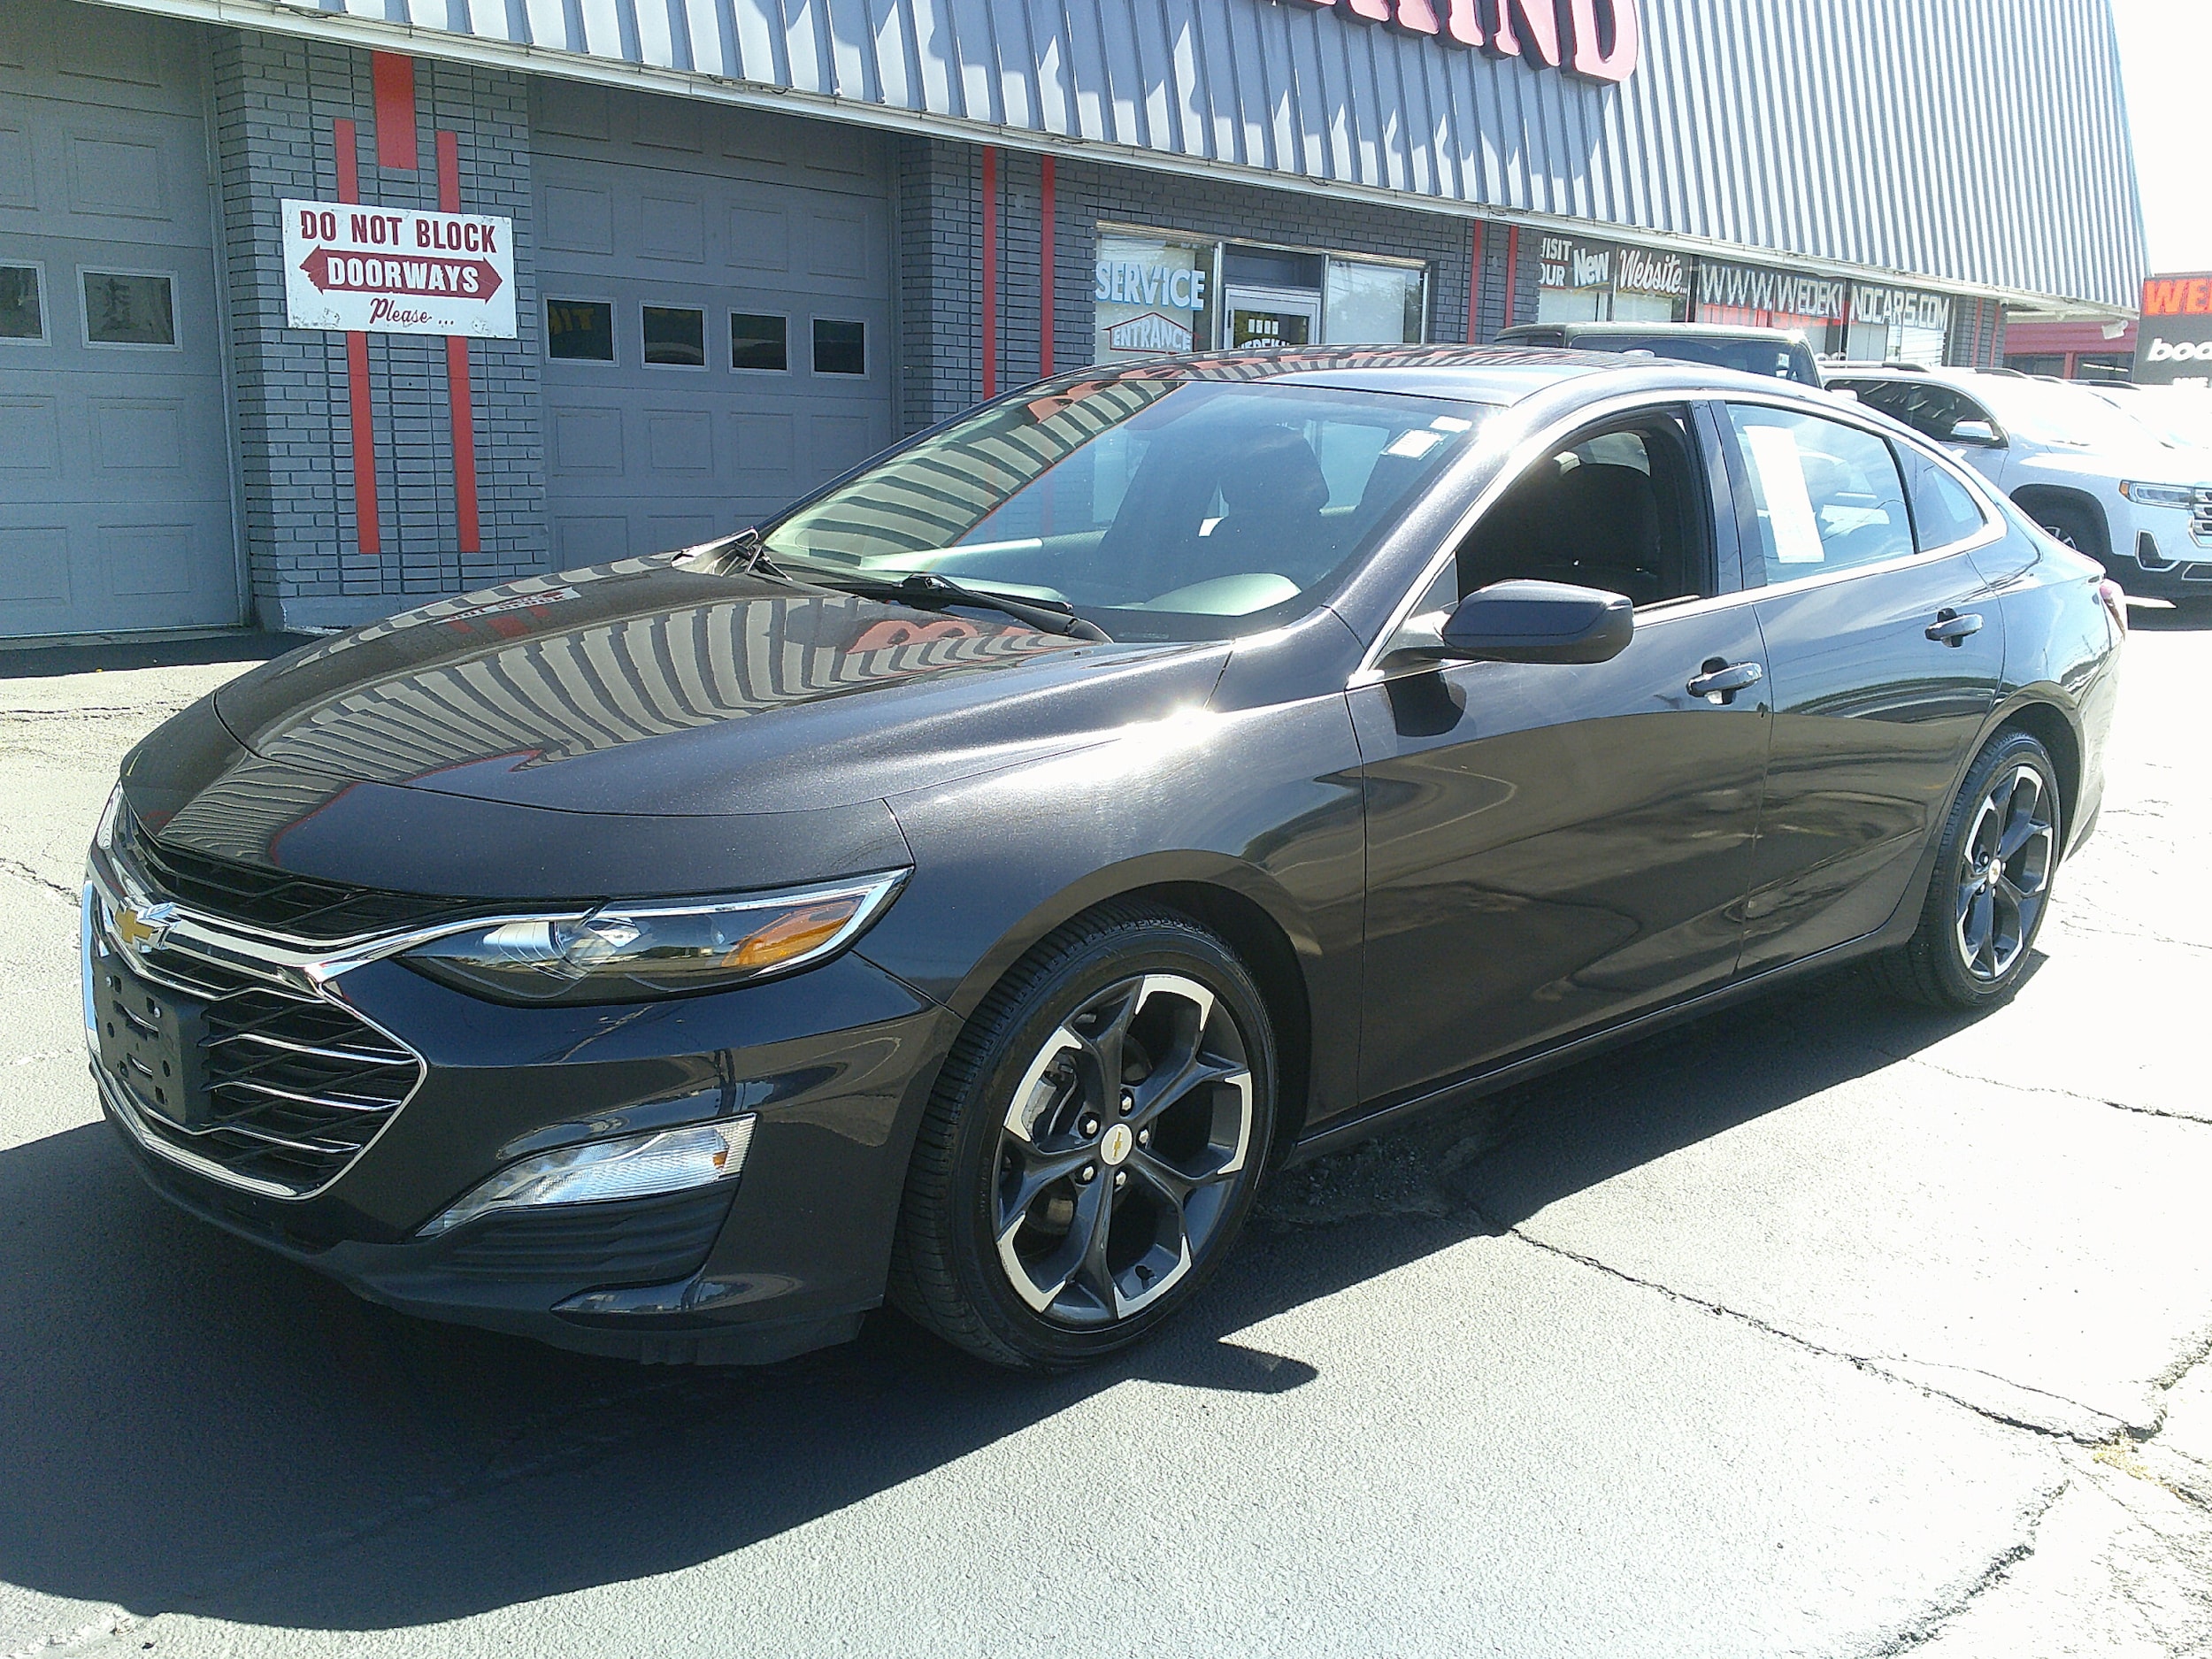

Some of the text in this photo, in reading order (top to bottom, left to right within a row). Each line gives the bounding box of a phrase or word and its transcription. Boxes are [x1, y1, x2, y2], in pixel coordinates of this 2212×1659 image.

[300, 211, 497, 253] DO NOT BLOCK
[326, 256, 480, 294] DOORWAYS
[1095, 260, 1205, 310] SERVICE
[1572, 248, 1610, 287] New
[369, 297, 432, 325] Please
[2144, 279, 2212, 316] WE
[1113, 316, 1192, 350] ENTRANCE
